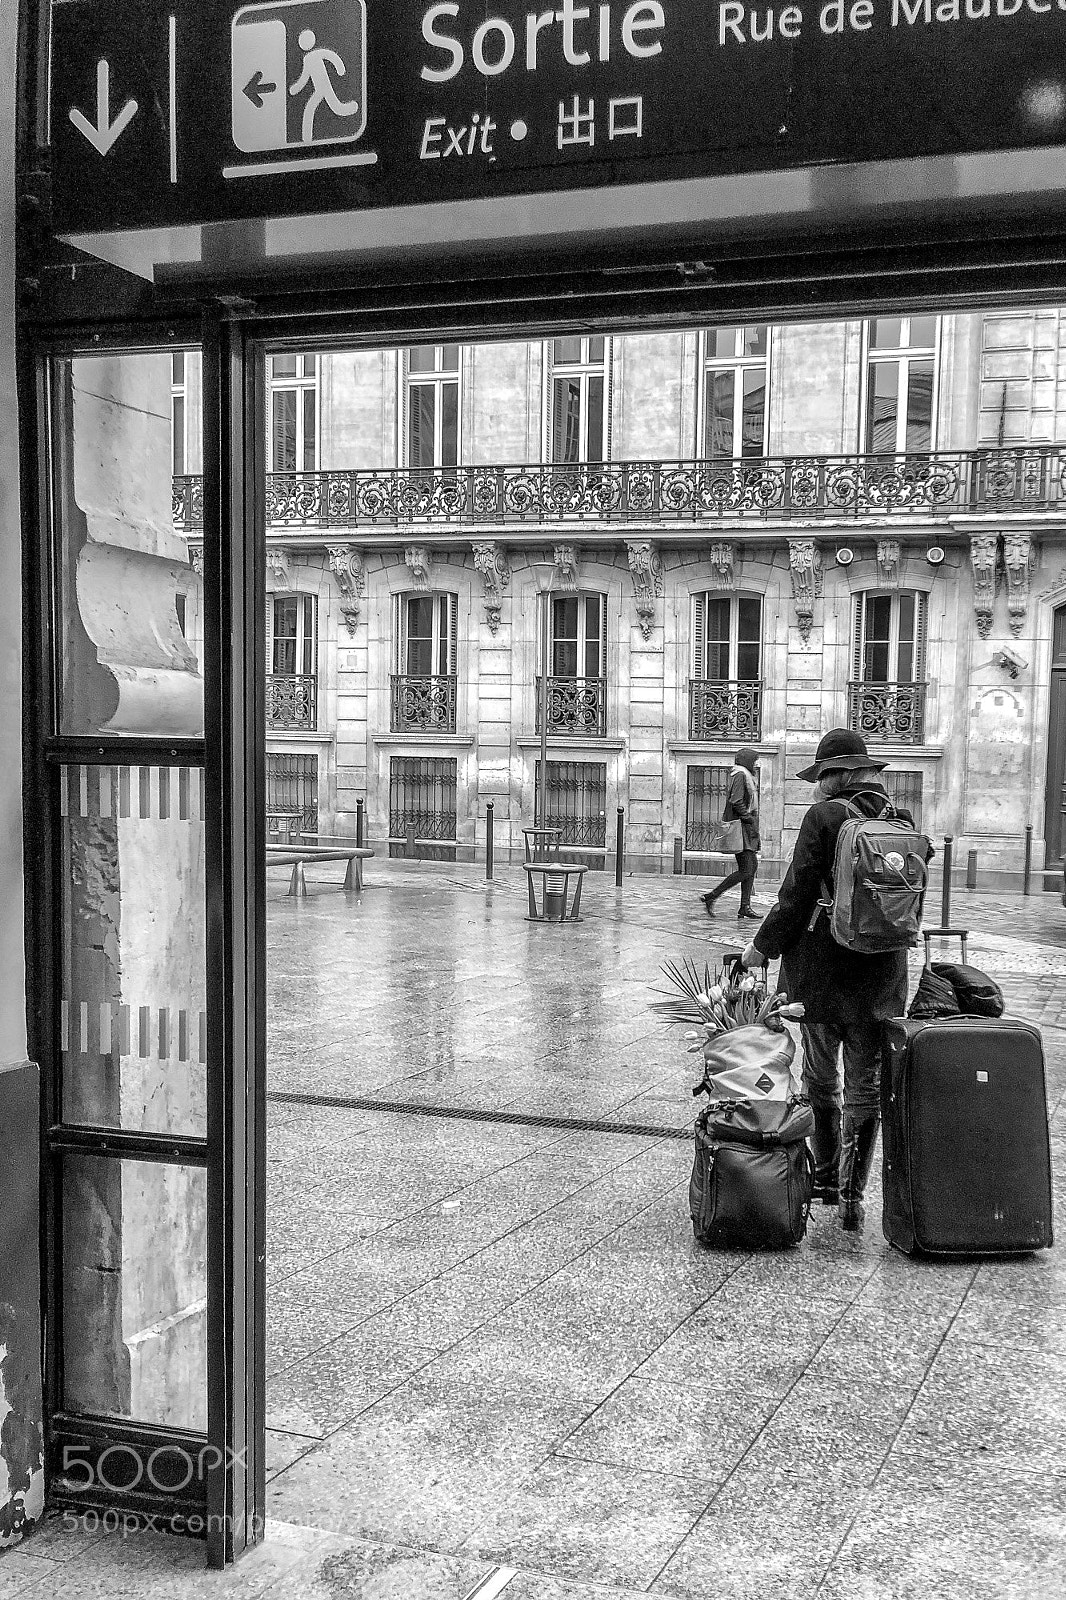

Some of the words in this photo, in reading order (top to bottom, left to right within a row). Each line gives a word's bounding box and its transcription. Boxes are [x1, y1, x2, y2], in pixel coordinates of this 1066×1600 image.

[420, 0, 665, 82] Sortie
[719, 2, 802, 45] Rue
[819, 0, 875, 34] de
[419, 113, 497, 159] Exit
[557, 95, 643, 149] 出口
